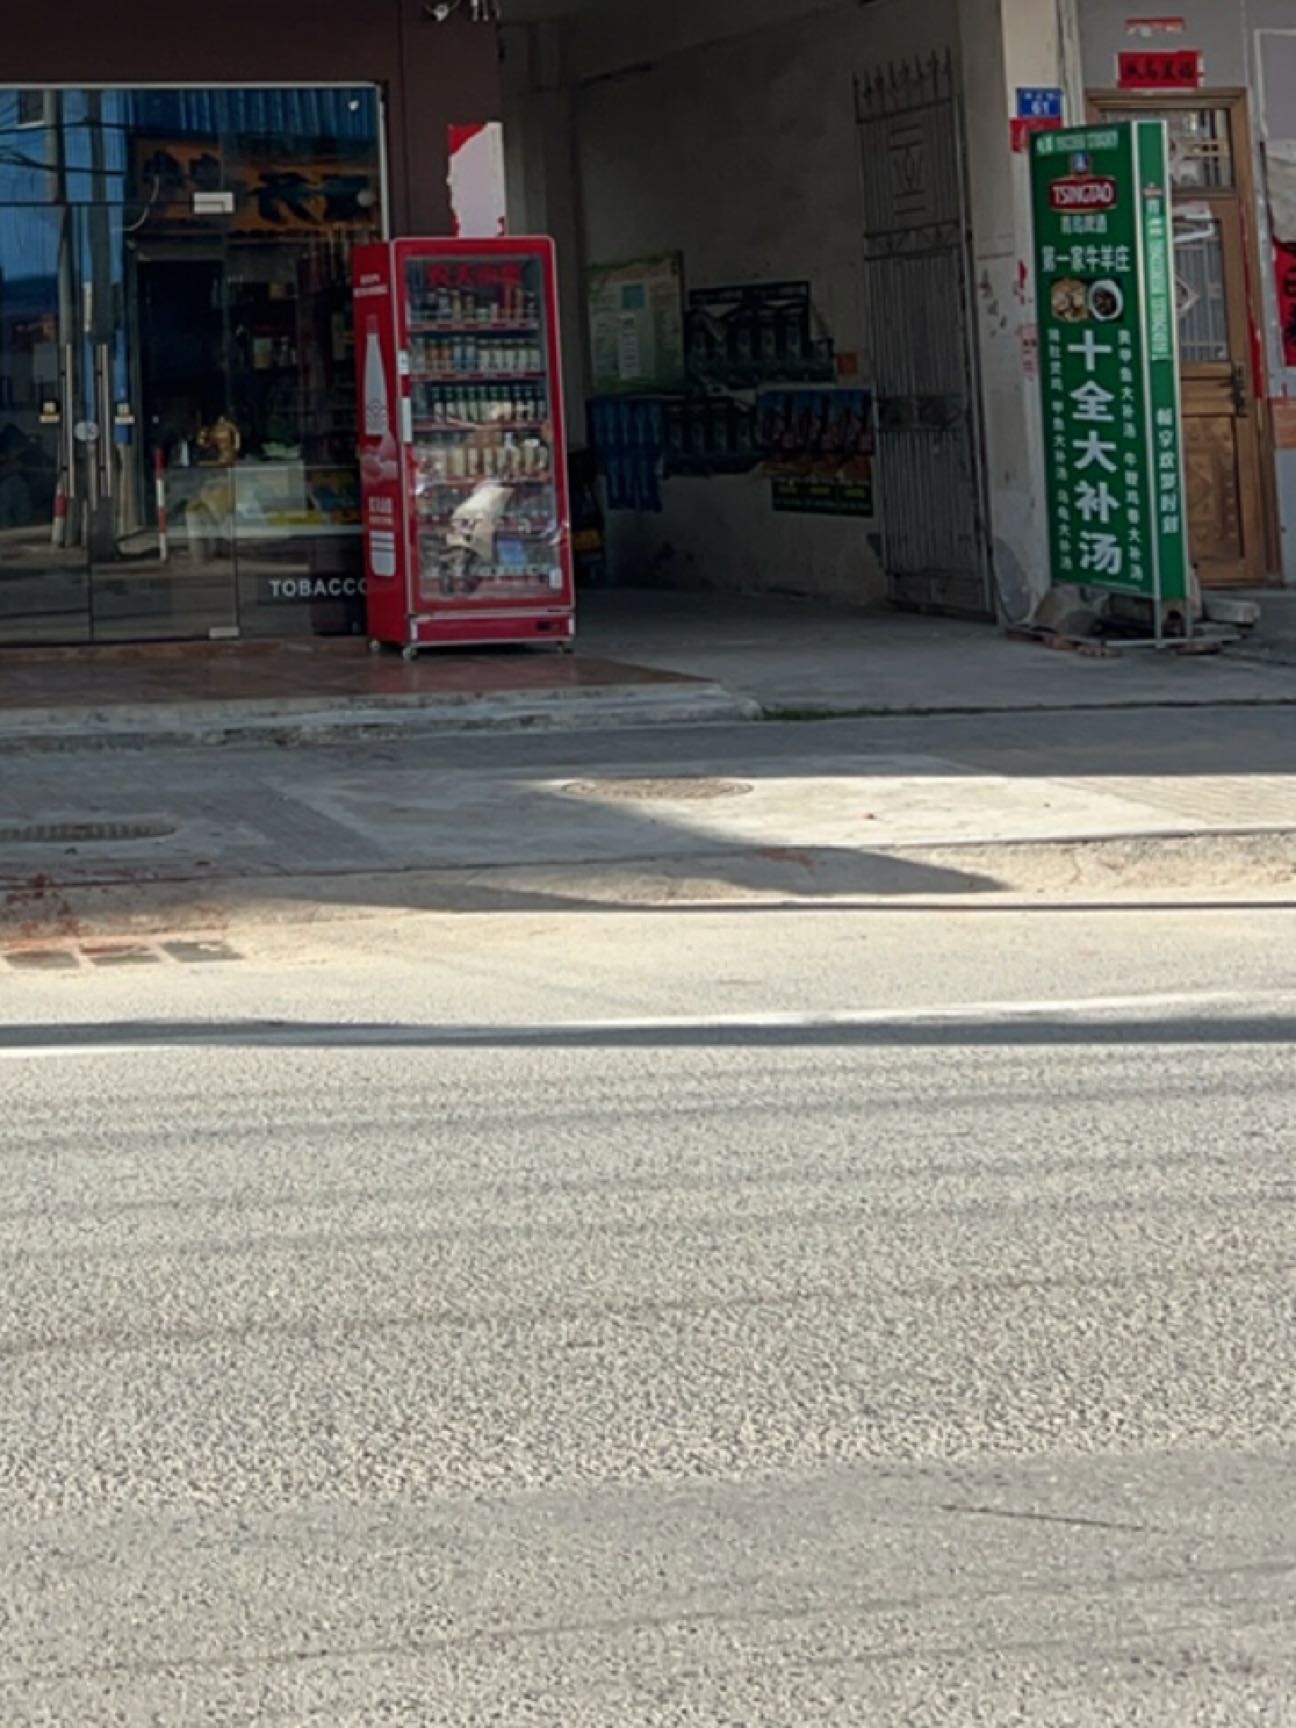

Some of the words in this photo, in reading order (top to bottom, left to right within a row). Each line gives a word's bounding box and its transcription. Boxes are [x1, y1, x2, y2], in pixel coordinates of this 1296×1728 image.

[1051, 181, 1114, 205] TSINGTAO
[1041, 244, 1131, 273] 第一家牛羊庄
[1066, 328, 1123, 575] 十全大补汤
